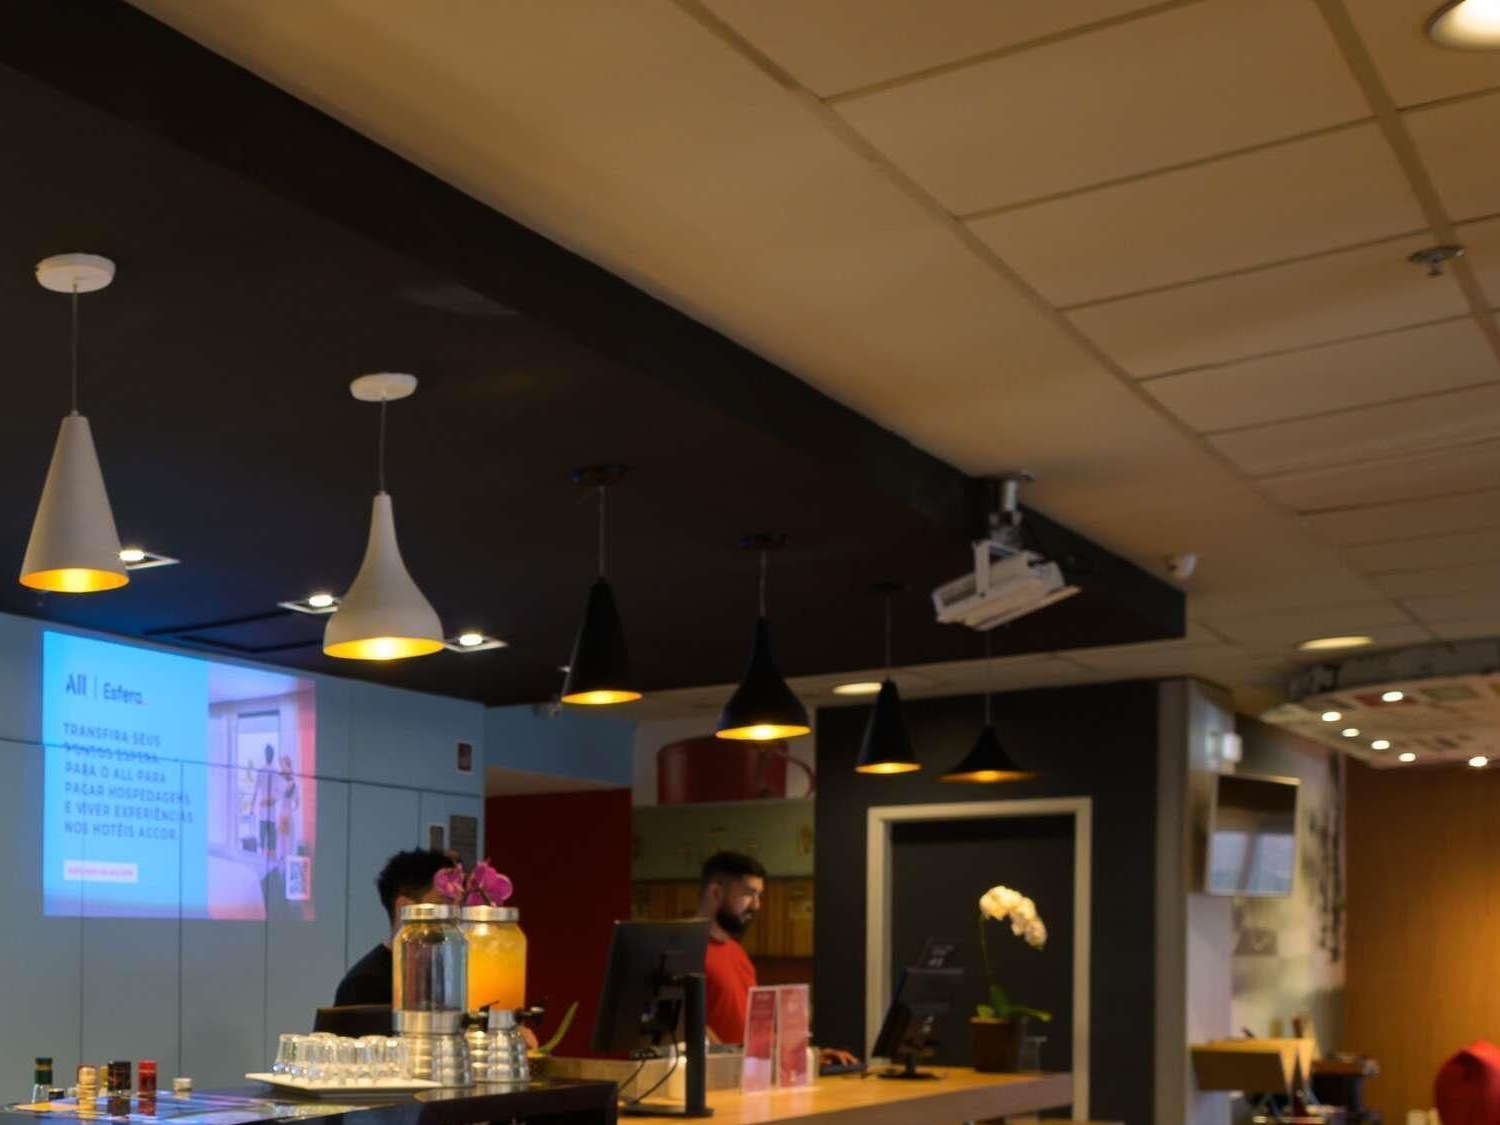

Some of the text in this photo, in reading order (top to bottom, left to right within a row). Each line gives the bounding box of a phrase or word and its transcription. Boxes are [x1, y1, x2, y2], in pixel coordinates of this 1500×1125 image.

[63, 722, 162, 748] TRANSFIRA SEUS
[65, 761, 167, 785] PARA O ALL PARA
[65, 781, 105, 797] PAGAR
[65, 801, 72, 814] E
[76, 801, 110, 817] VIVER
[64, 820, 89, 836] NOS
